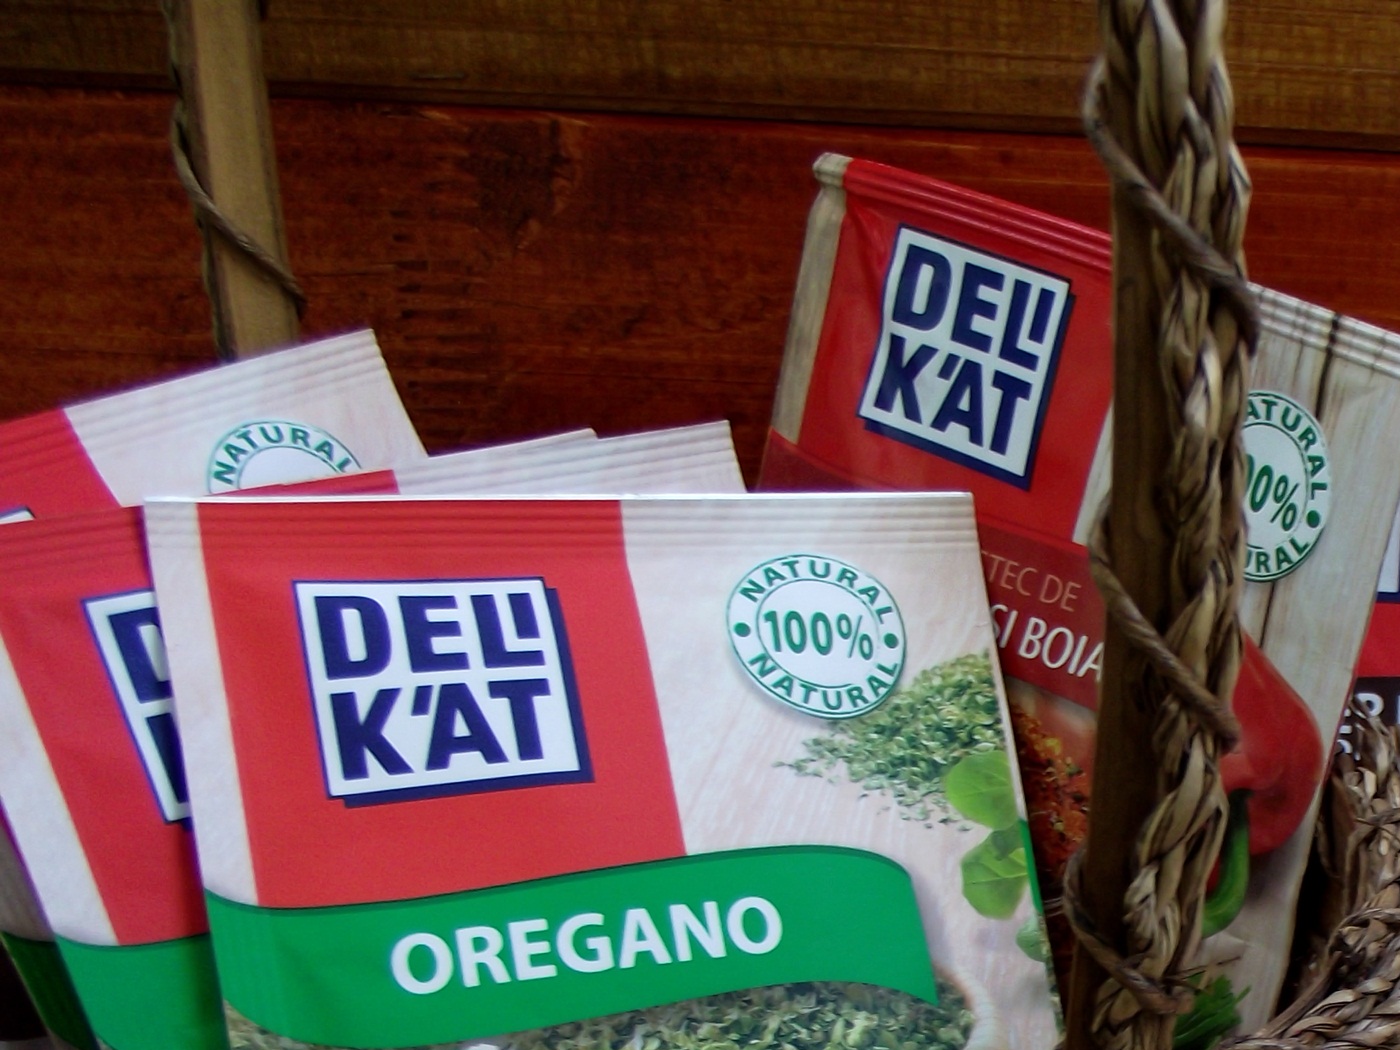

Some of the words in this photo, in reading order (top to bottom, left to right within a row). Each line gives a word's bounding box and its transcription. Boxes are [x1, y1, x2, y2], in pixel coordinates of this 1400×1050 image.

[892, 243, 1055, 371] DELI
[212, 425, 353, 486] NATURAL
[1247, 398, 1328, 500] ATURAL
[1244, 453, 1300, 532] 0%
[738, 559, 893, 625] NATURAL
[1039, 574, 1082, 612] DE
[313, 591, 547, 681] DELI
[763, 609, 874, 661] 100%
[1017, 616, 1104, 682] BOIA
[747, 652, 900, 711] NATURAL
[389, 895, 783, 995] OREGANO
